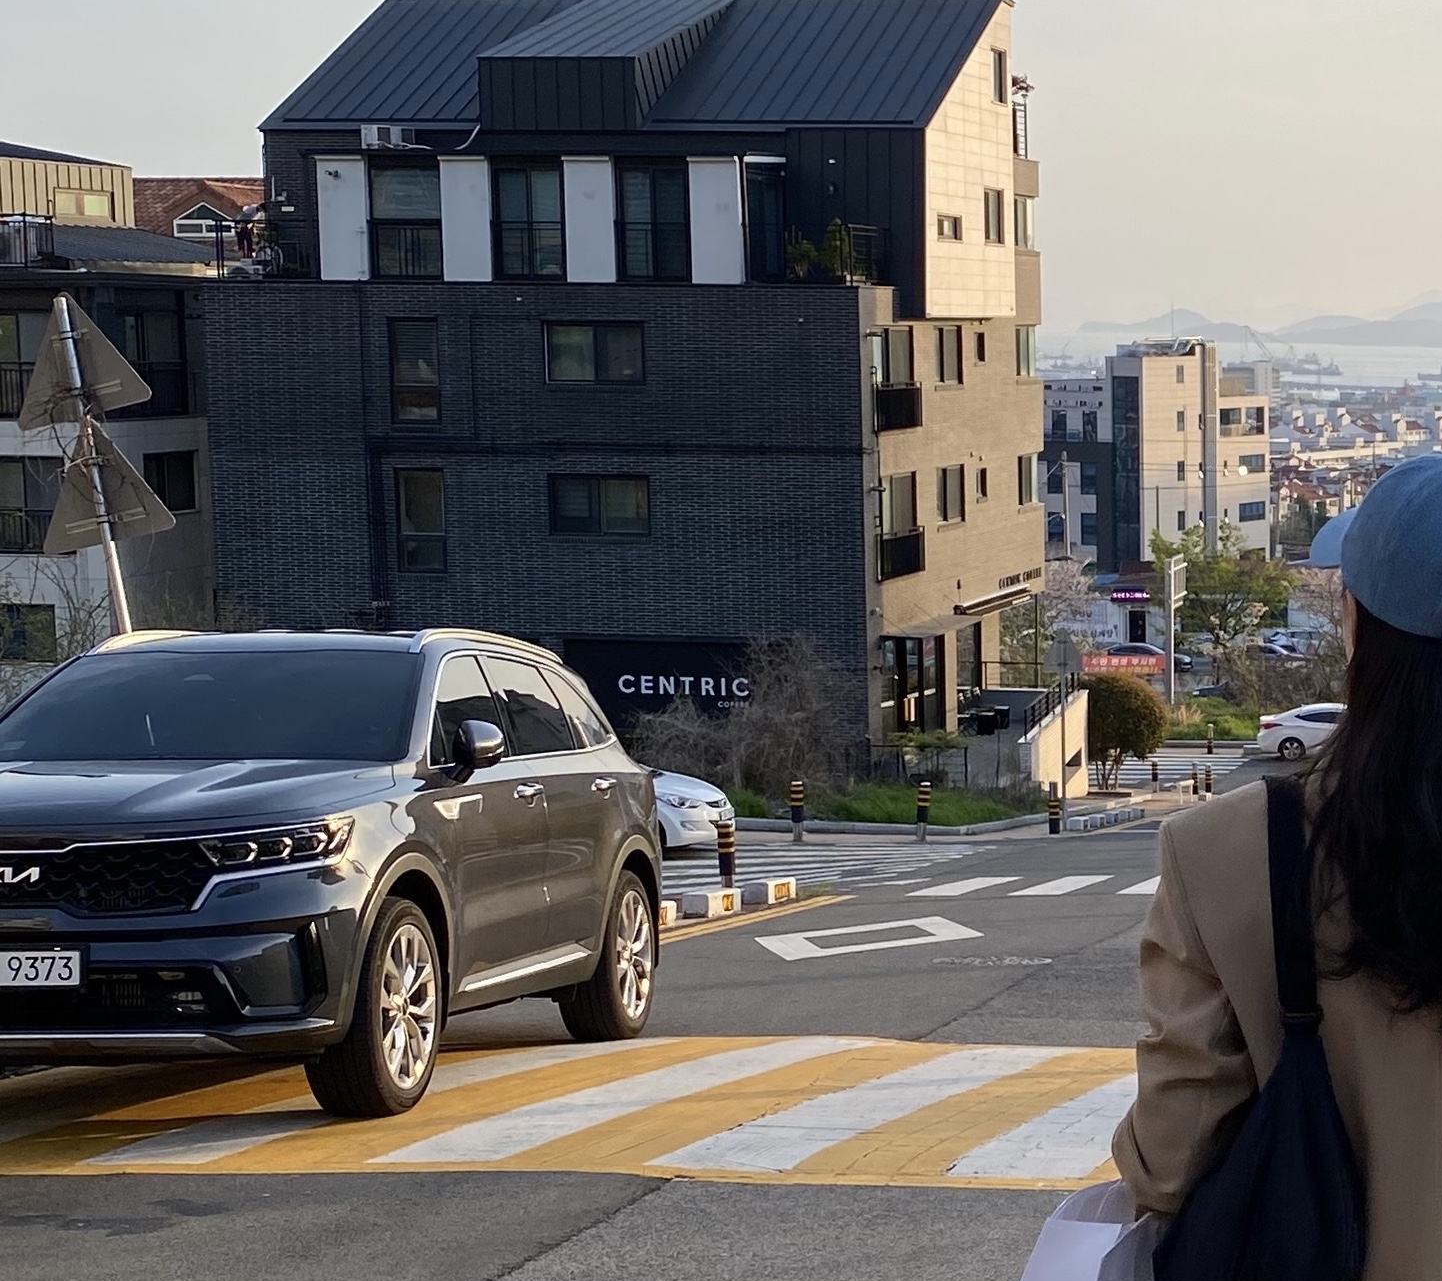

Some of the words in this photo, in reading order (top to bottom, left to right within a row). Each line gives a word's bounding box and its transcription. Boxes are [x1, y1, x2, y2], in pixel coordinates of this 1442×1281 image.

[618, 674, 750, 697] CENTRIC
[0, 866, 40, 883] IA
[7, 956, 73, 982] 9373
